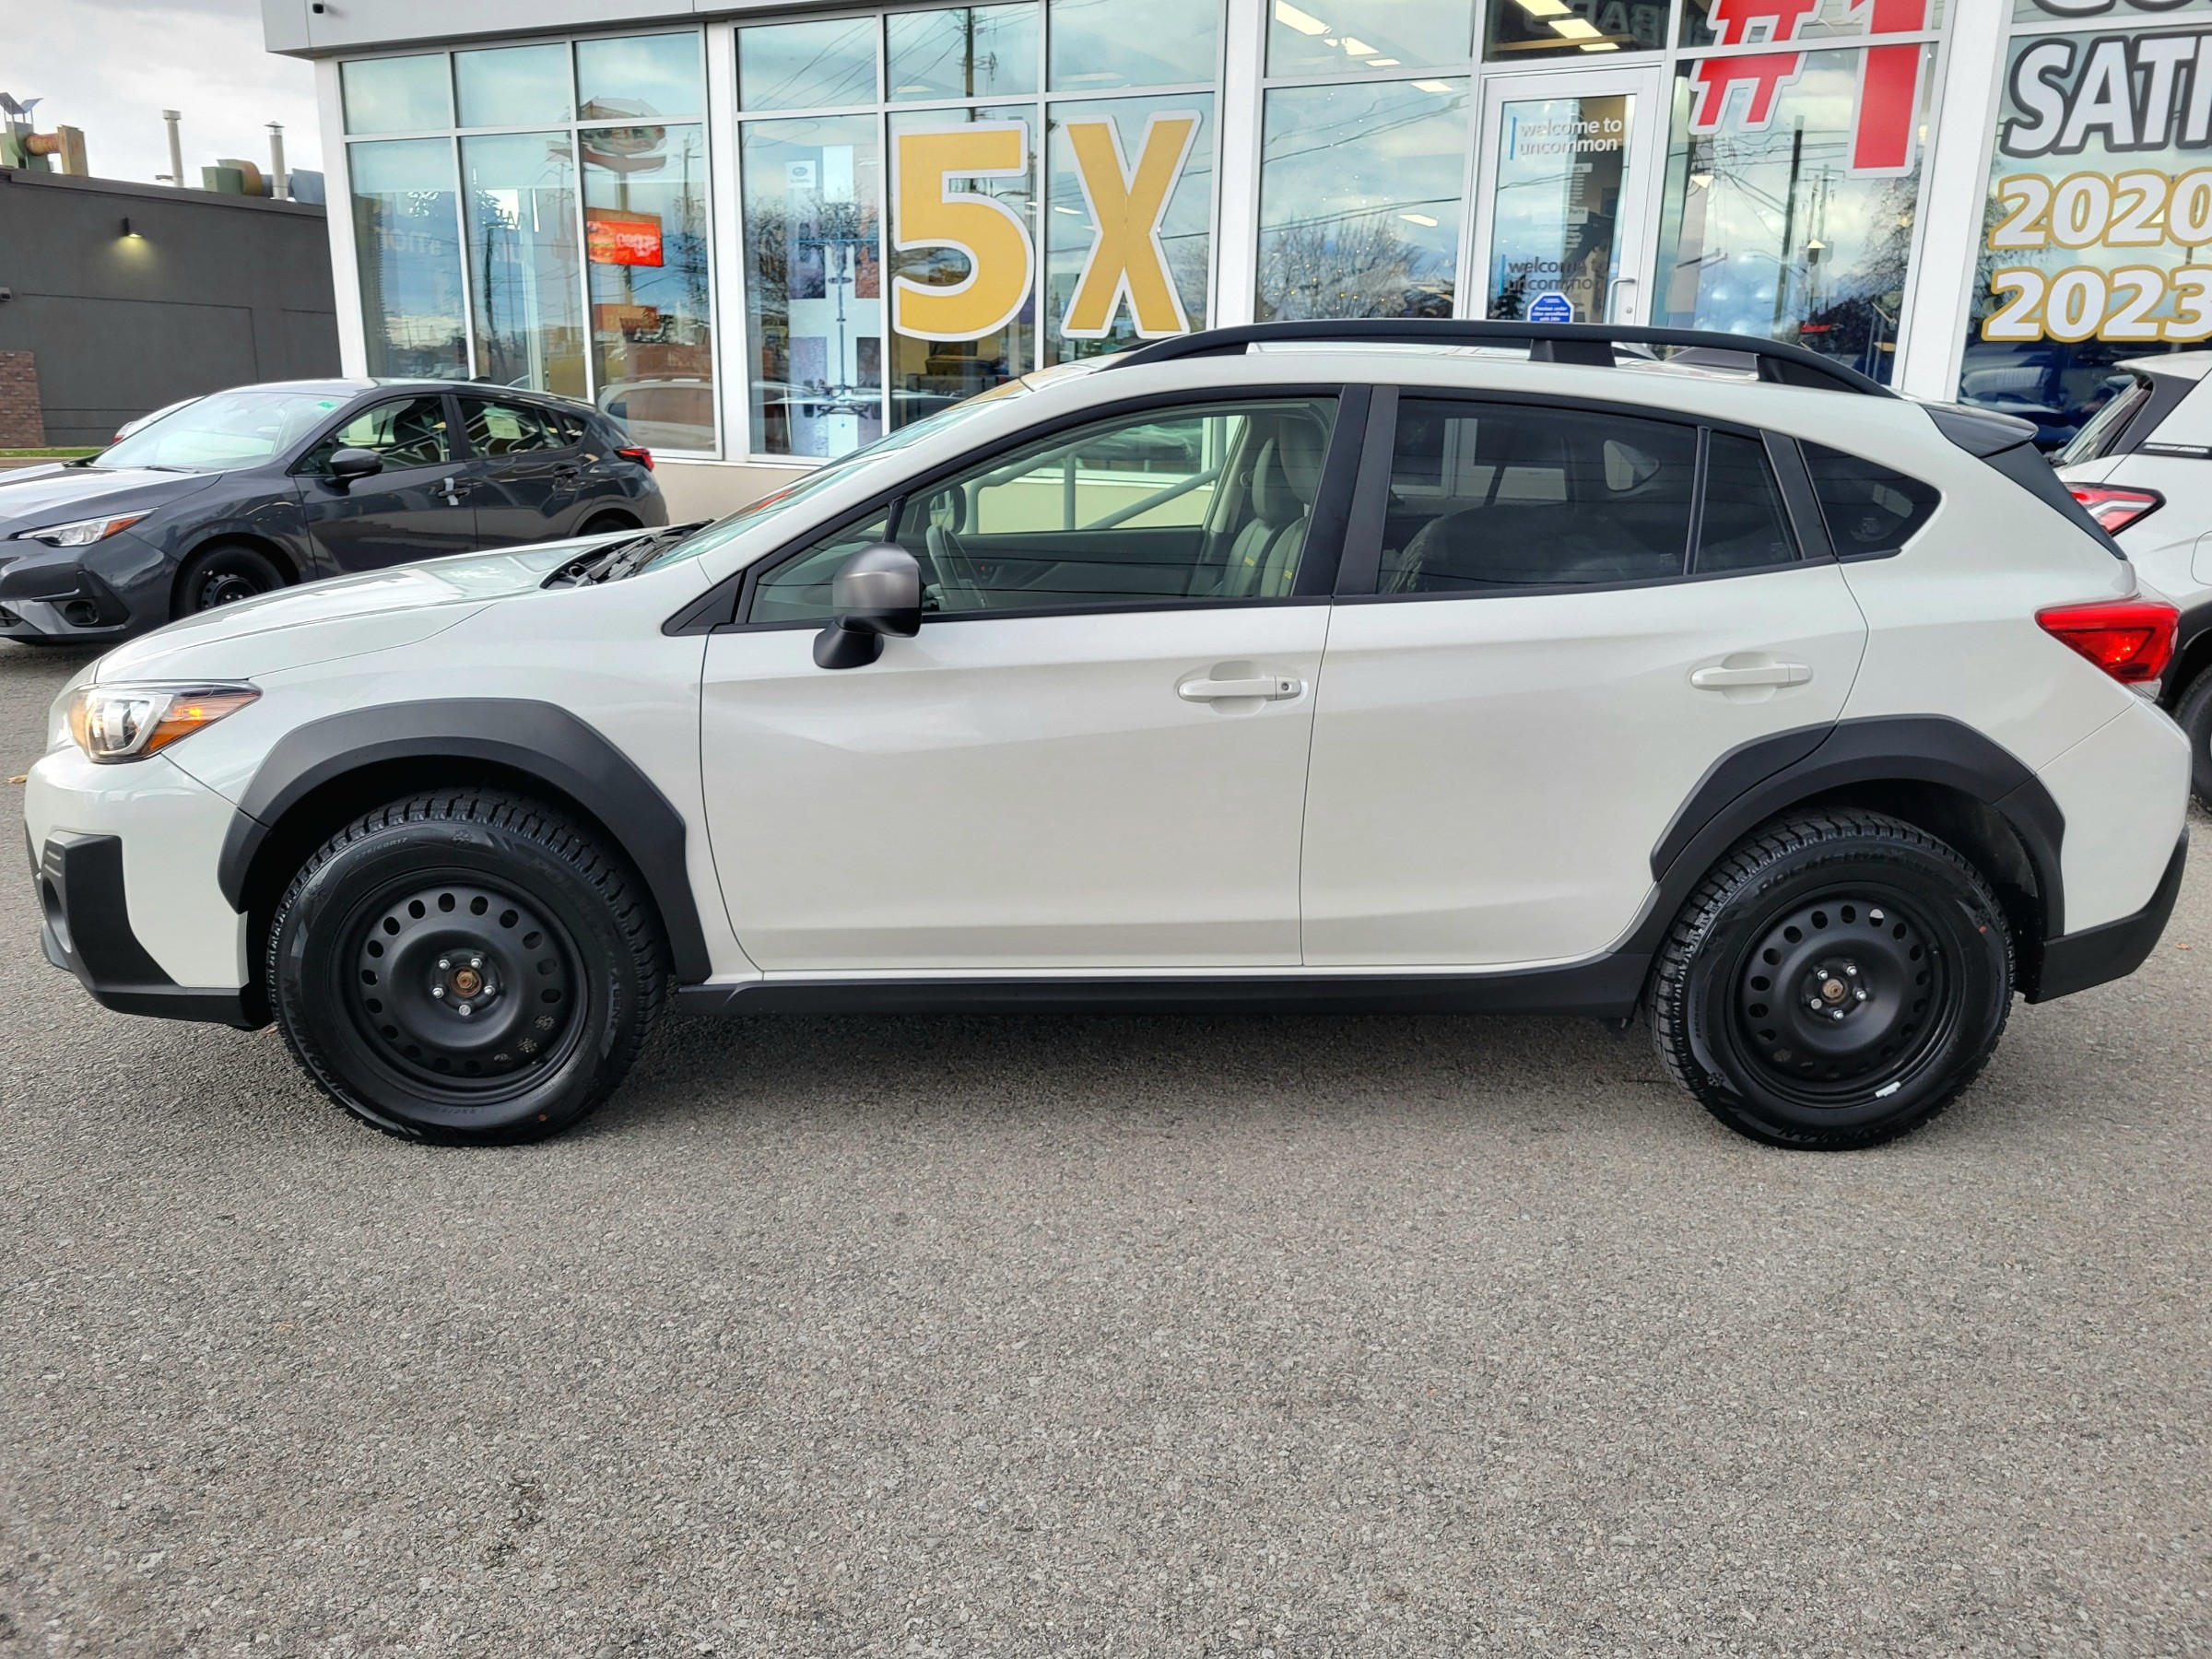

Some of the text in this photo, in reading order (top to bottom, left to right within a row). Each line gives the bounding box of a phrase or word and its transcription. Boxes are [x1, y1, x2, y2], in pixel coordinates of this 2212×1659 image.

[1521, 117, 1622, 137] welcome to
[2000, 34, 2212, 159] SATI
[1520, 137, 1619, 156] uncommon
[892, 110, 1202, 342] 5X
[1988, 167, 2212, 250] 2020
[1508, 277, 1600, 292] uncommo
[1983, 264, 2212, 342] 2023
